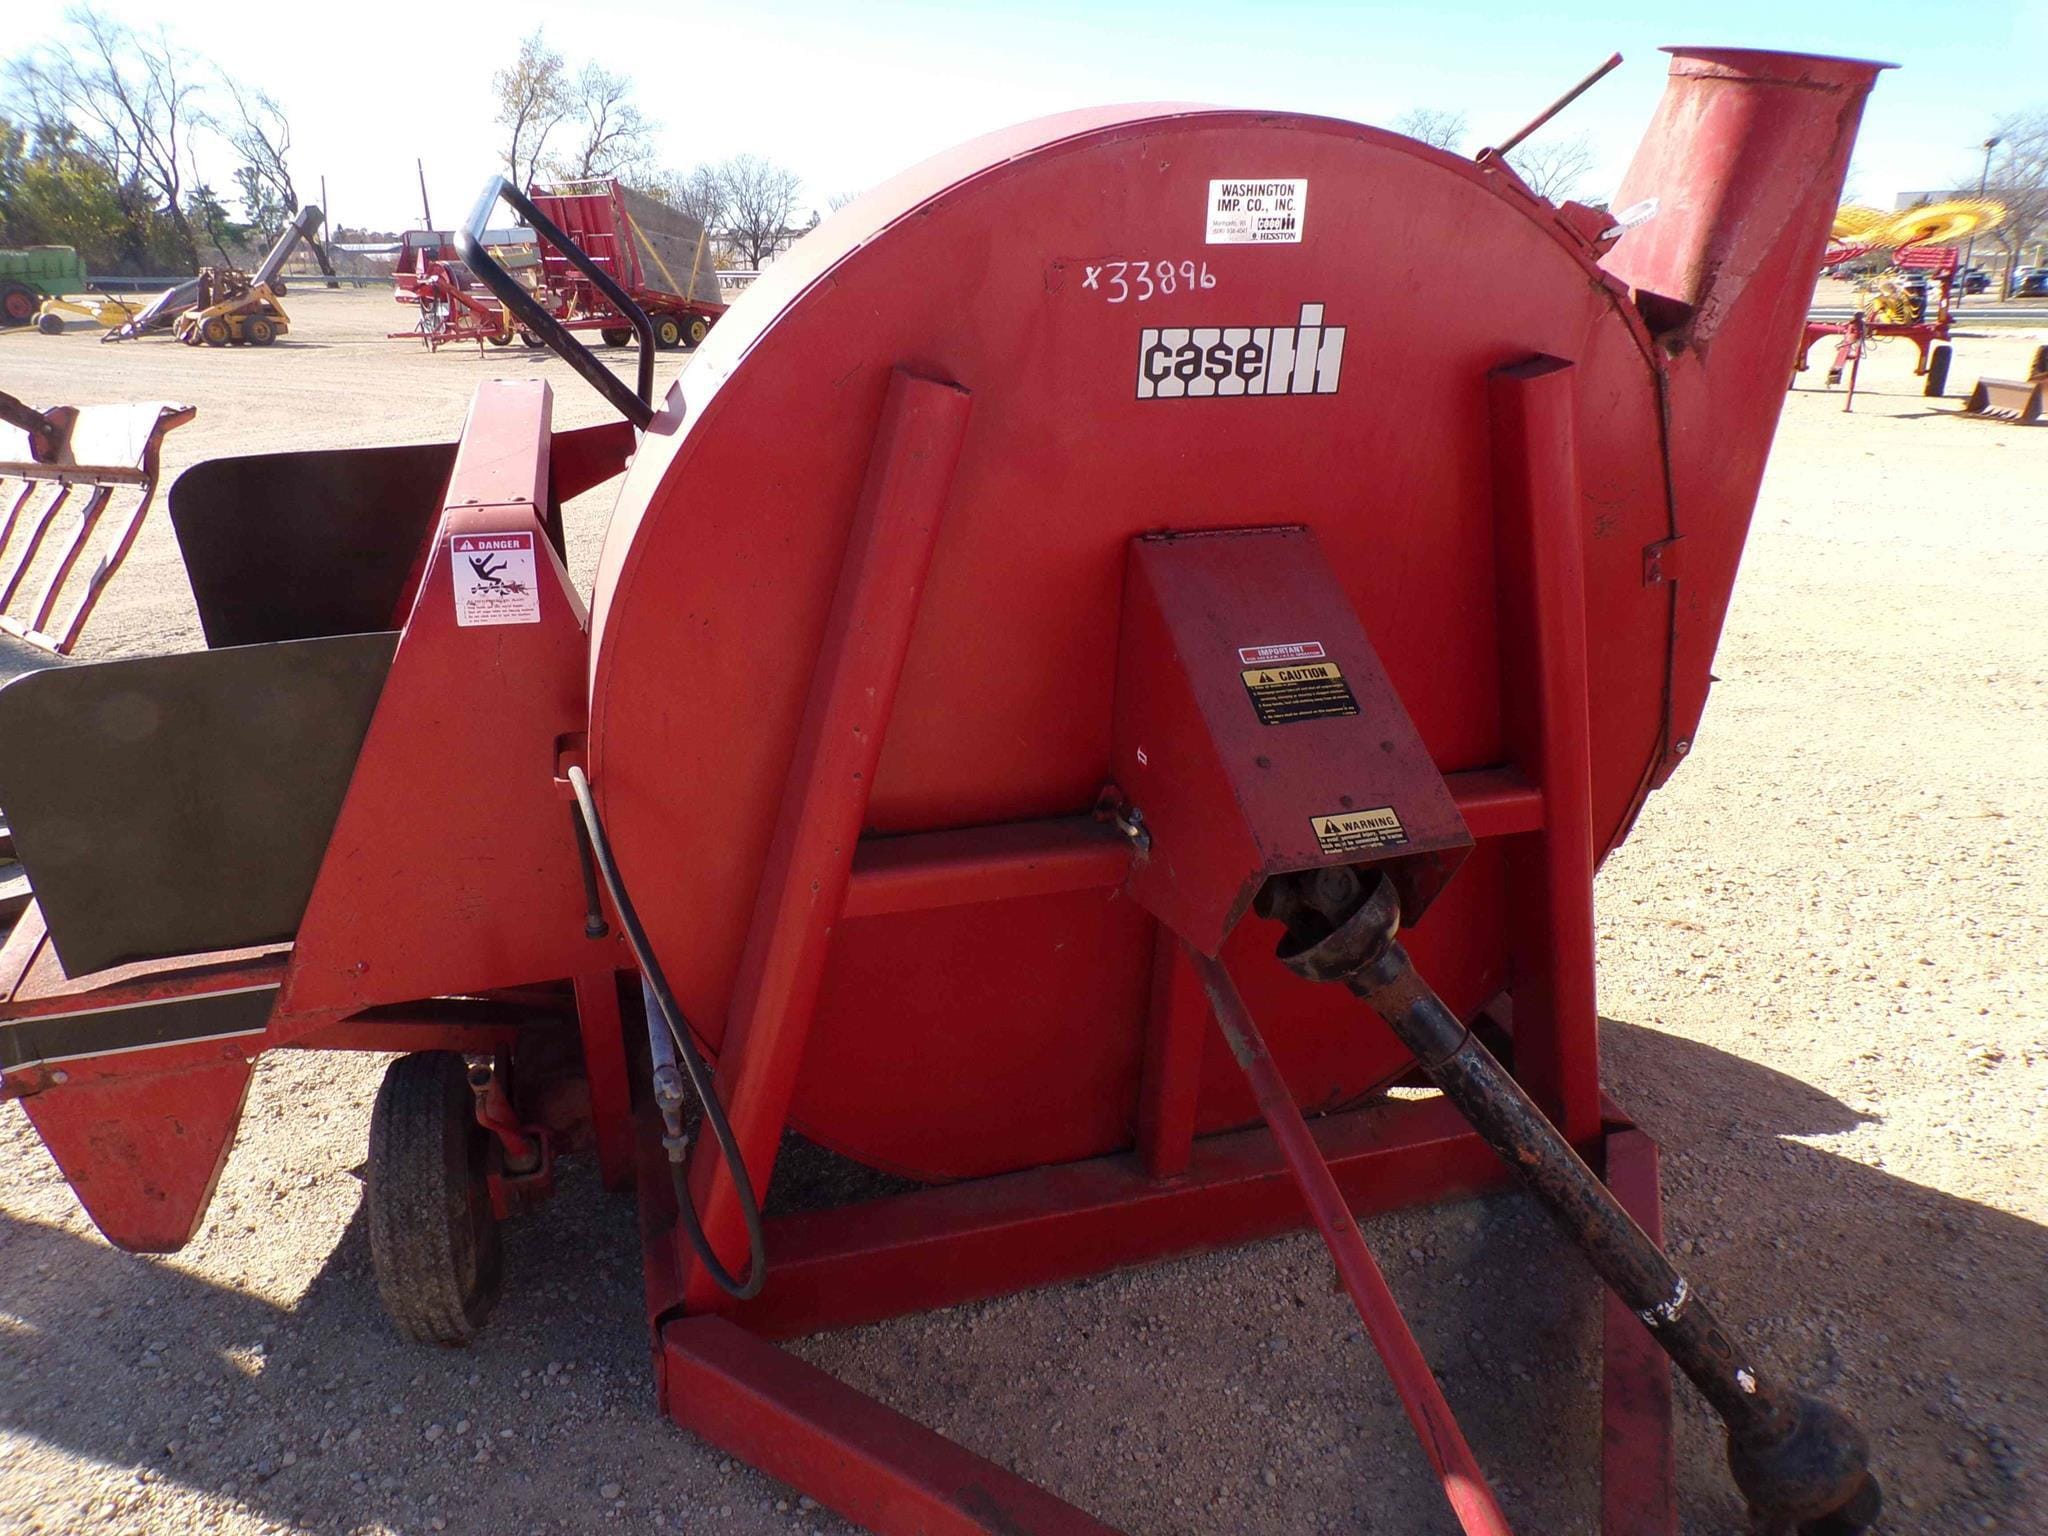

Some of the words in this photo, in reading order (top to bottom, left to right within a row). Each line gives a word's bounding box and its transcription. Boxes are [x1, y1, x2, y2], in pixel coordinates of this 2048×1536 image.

[1221, 184, 1296, 197] WASHINGTON
[1217, 199, 1241, 212] IMP.
[1274, 198, 1297, 211] INC.
[1260, 232, 1296, 240] HESSTON
[478, 540, 520, 550] DANGER
[1257, 645, 1304, 657] IMPORTANT
[1279, 666, 1329, 681] CAUTION
[1342, 816, 1395, 832] WARNING
